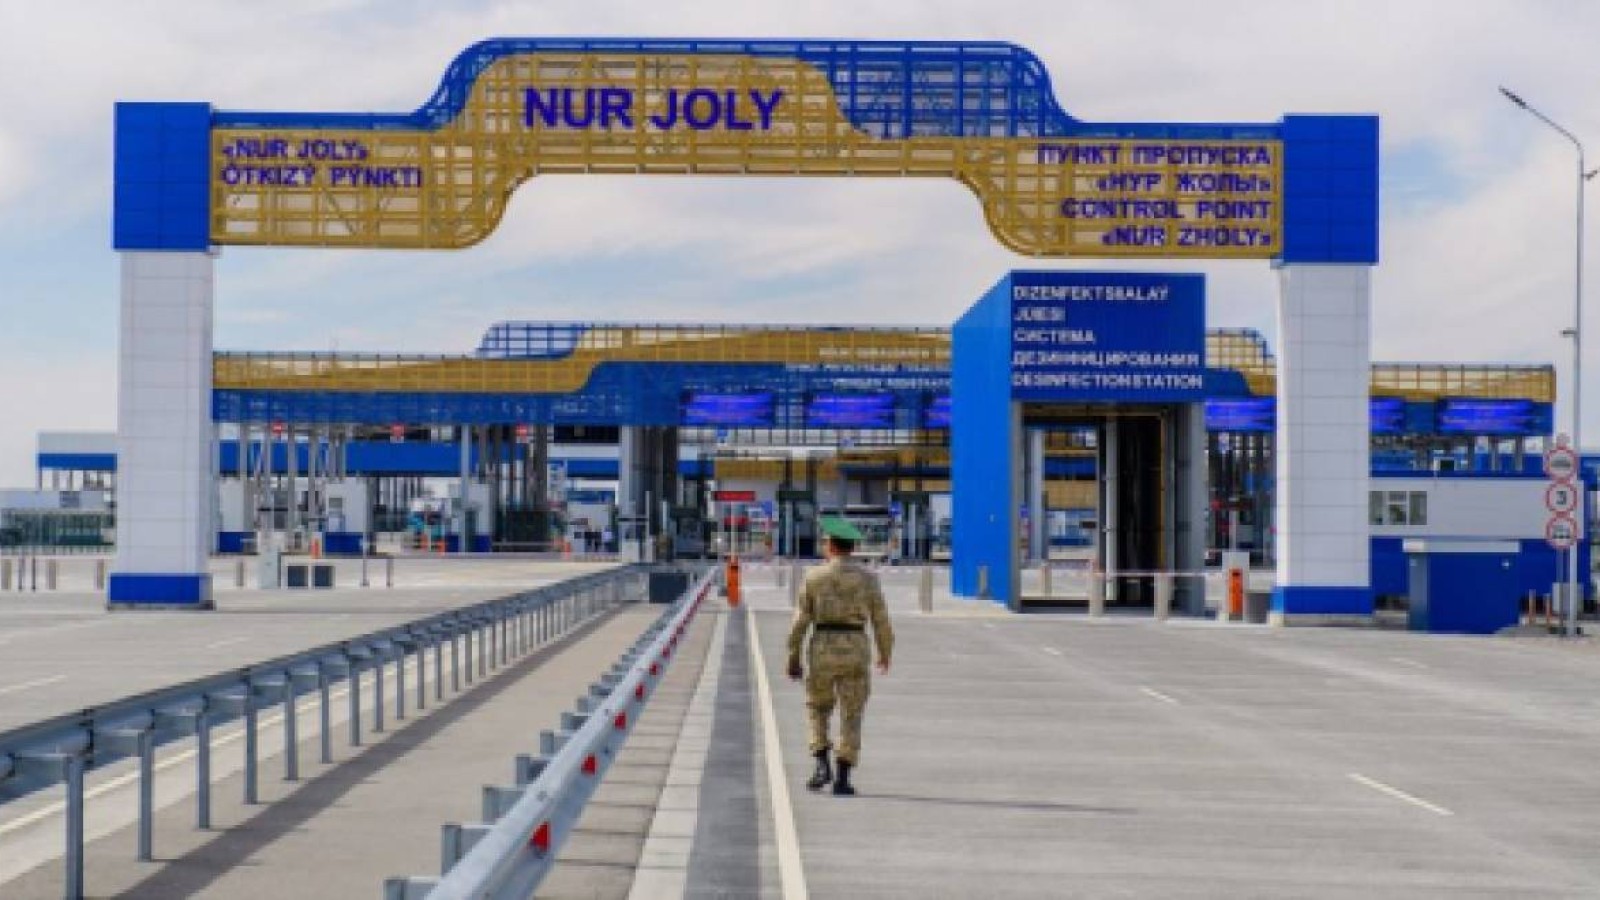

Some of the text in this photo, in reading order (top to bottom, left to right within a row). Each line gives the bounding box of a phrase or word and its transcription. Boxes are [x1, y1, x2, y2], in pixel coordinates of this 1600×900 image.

[524, 87, 785, 130] NUR JOLY
[1037, 144, 1271, 165] ПУНКТ ПРОПУСКА
[1060, 198, 1272, 219] CONTROL POINT
[1013, 329, 1096, 344] СИСТЕМА
[1555, 490, 1568, 506] 3
